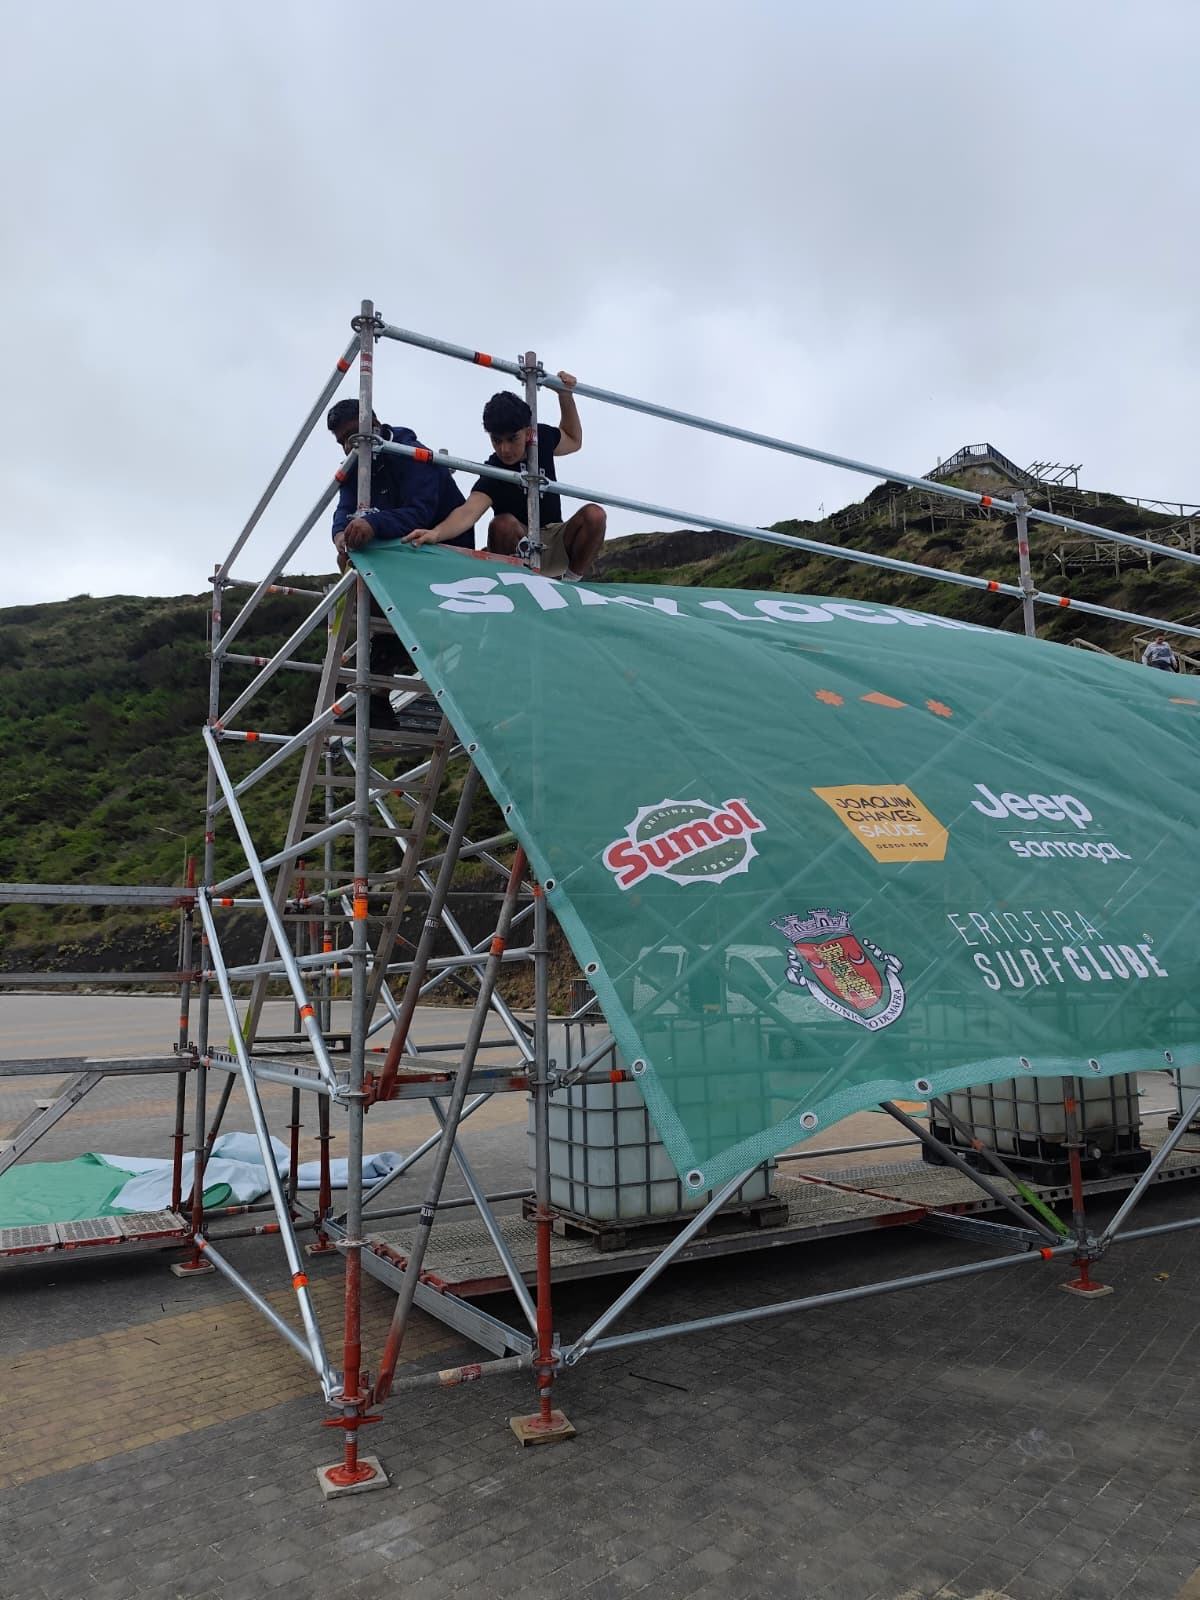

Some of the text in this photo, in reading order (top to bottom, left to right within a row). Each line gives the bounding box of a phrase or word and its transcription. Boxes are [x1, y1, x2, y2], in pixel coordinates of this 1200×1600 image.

[835, 796, 917, 809] JOAQUIM
[846, 810, 922, 822] CHAVES
[970, 783, 1093, 830] Jeep
[644, 807, 695, 831] ORIGINAL
[606, 800, 762, 887] Sumol
[946, 910, 1104, 946] ERICEIRA
